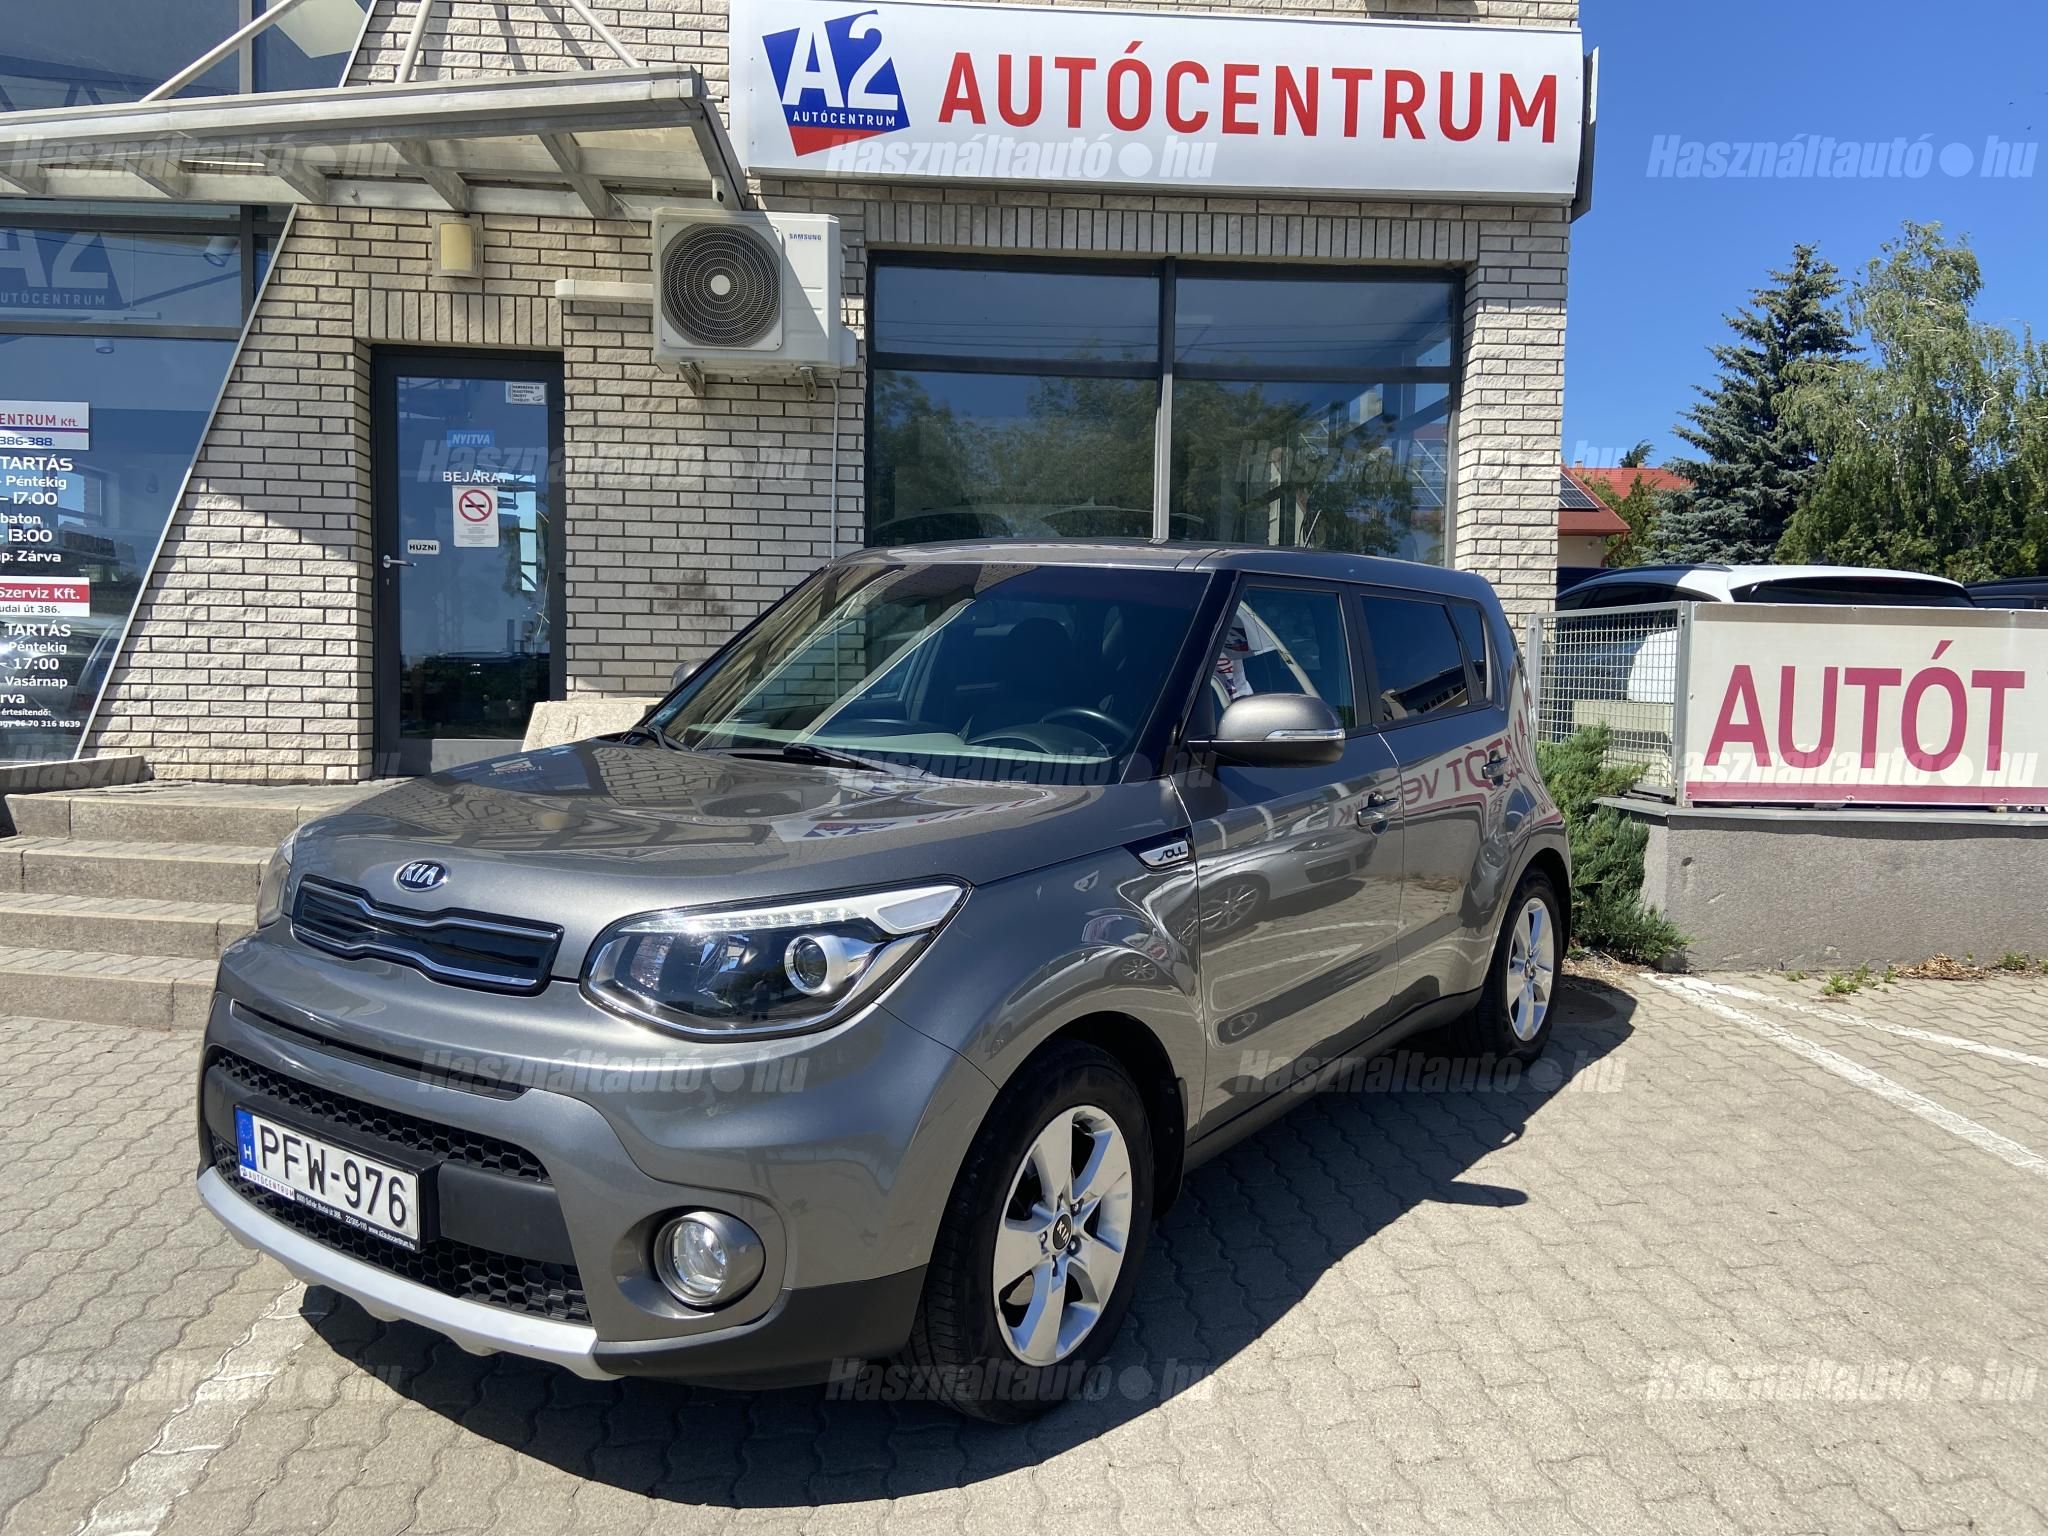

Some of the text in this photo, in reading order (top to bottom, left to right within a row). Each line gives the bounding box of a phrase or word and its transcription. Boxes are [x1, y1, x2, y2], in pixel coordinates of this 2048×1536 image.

[782, 13, 898, 111] A2
[938, 41, 1557, 144] AUTÓCENTRUM
[793, 110, 896, 127] AUTÓCENTRUM
[789, 233, 822, 241] SAMSUNG
[0, 413, 56, 426] ENTRUM
[452, 433, 490, 445] NYITVA
[6, 475, 67, 491] Péntekig
[13, 491, 58, 505] 17:00
[8, 528, 53, 543] 13:00
[17, 550, 62, 562] Zárva
[0, 587, 80, 600] Szerviz Kft.
[38, 605, 60, 614] 386.
[4, 620, 72, 638] TARTÁS
[8, 641, 68, 656] Péntekig
[14, 657, 60, 671] 17:00
[4, 675, 68, 690] Vasárnap
[1704, 640, 2026, 773] AUTÓT
[41, 720, 57, 728] 316
[59, 720, 81, 728] 8639
[400, 863, 440, 886] KIA
[243, 1144, 253, 1162] H
[259, 1124, 407, 1228] PFW-976
